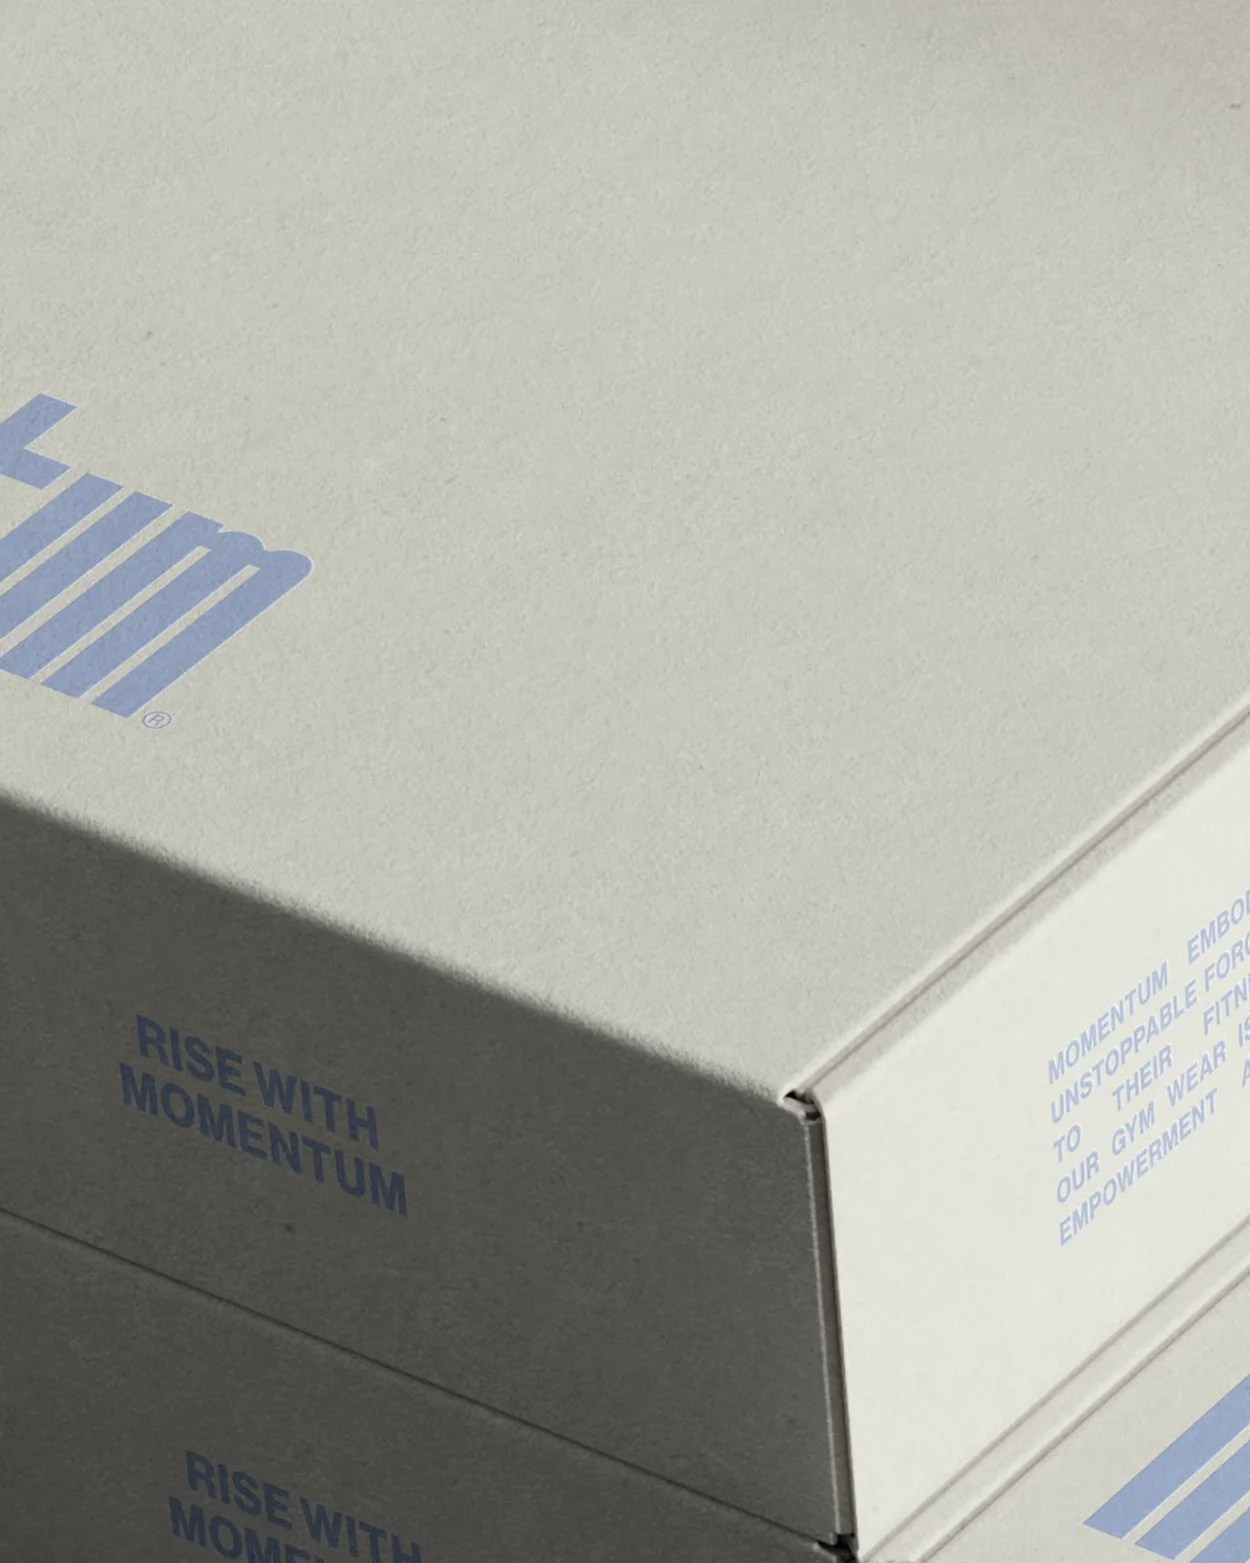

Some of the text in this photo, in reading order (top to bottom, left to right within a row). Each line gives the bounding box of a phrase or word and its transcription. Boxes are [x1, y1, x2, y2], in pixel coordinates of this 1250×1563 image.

[135, 1016, 379, 1148] RISE WITH
[1047, 961, 1169, 1083] MOMENTUM
[1050, 980, 1197, 1126] UNSTOPPABLE
[120, 1064, 407, 1214] MOMENTUM
[1052, 1124, 1082, 1161] TO
[1111, 1044, 1173, 1111] THEIR
[1055, 1150, 1100, 1205] OUR
[1110, 1099, 1156, 1157] GYM
[1167, 1040, 1227, 1105] WEAR
[1058, 1088, 1217, 1248] EMPOWERMENT
[185, 1450, 290, 1530] RISE
